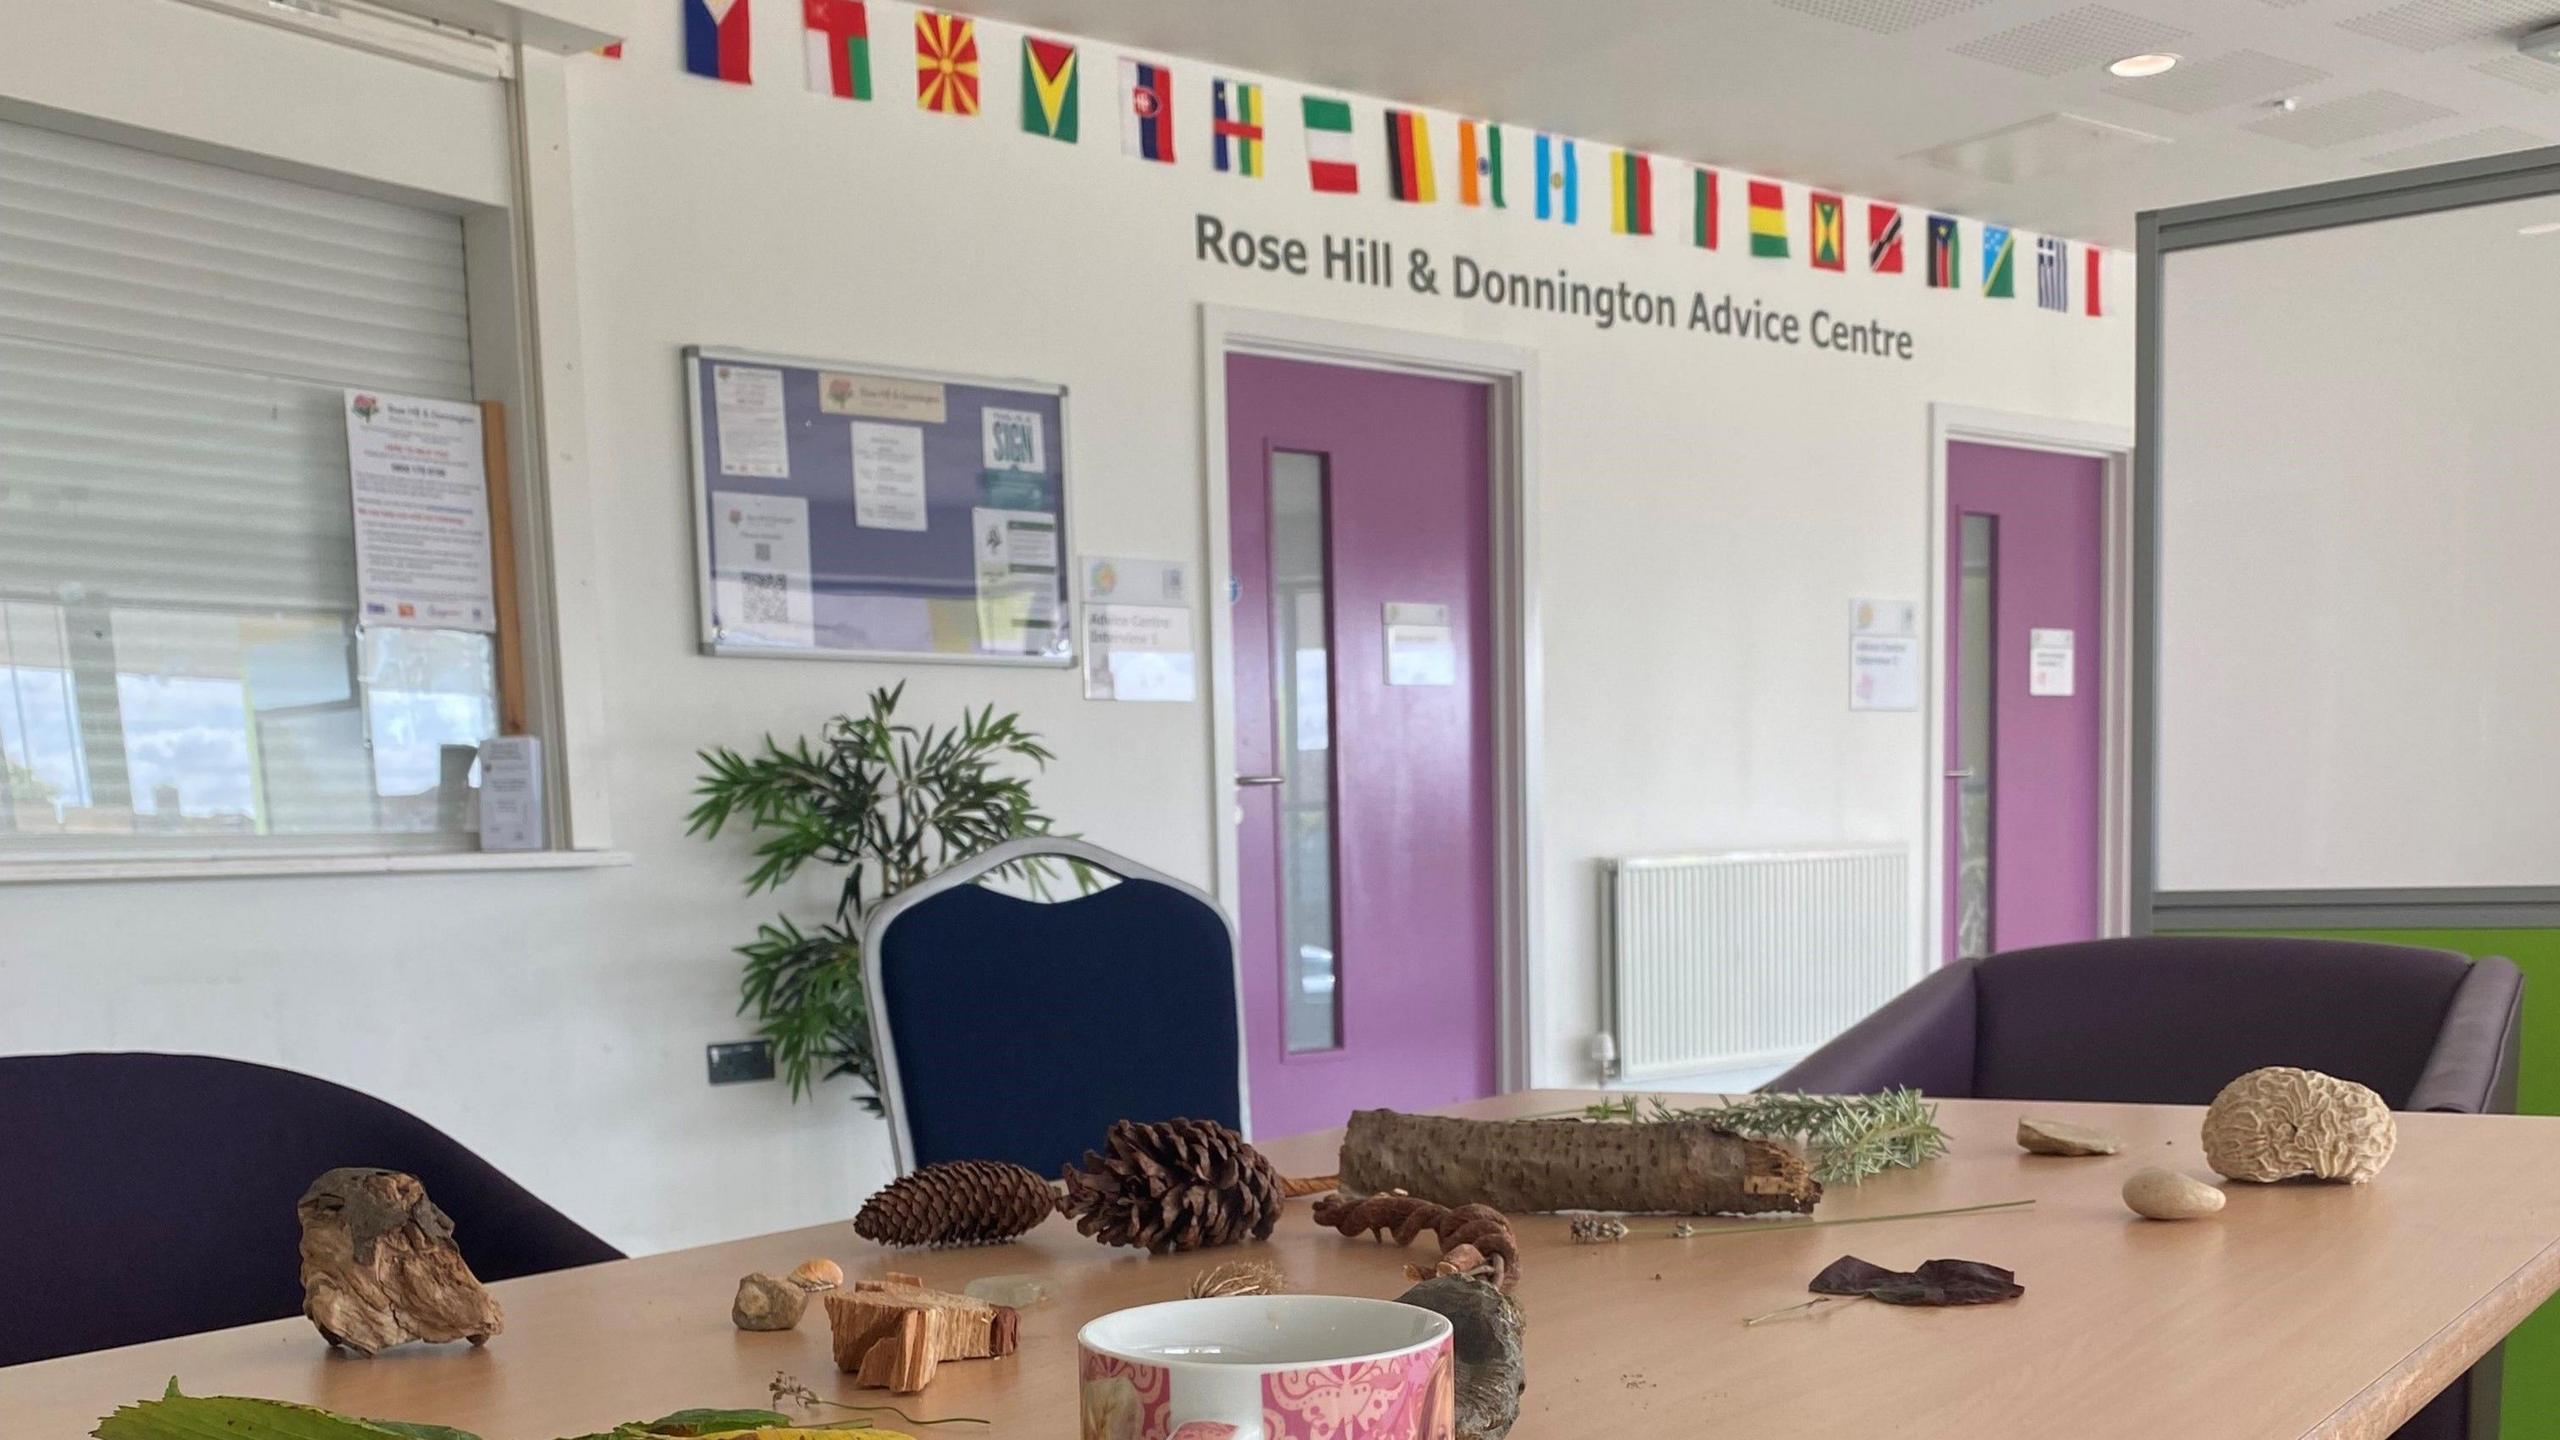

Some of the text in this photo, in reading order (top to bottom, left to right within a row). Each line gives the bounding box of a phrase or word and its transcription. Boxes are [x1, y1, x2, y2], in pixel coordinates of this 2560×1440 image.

[1196, 214, 1913, 361] Rose Hill & Donnington Advice Centre
